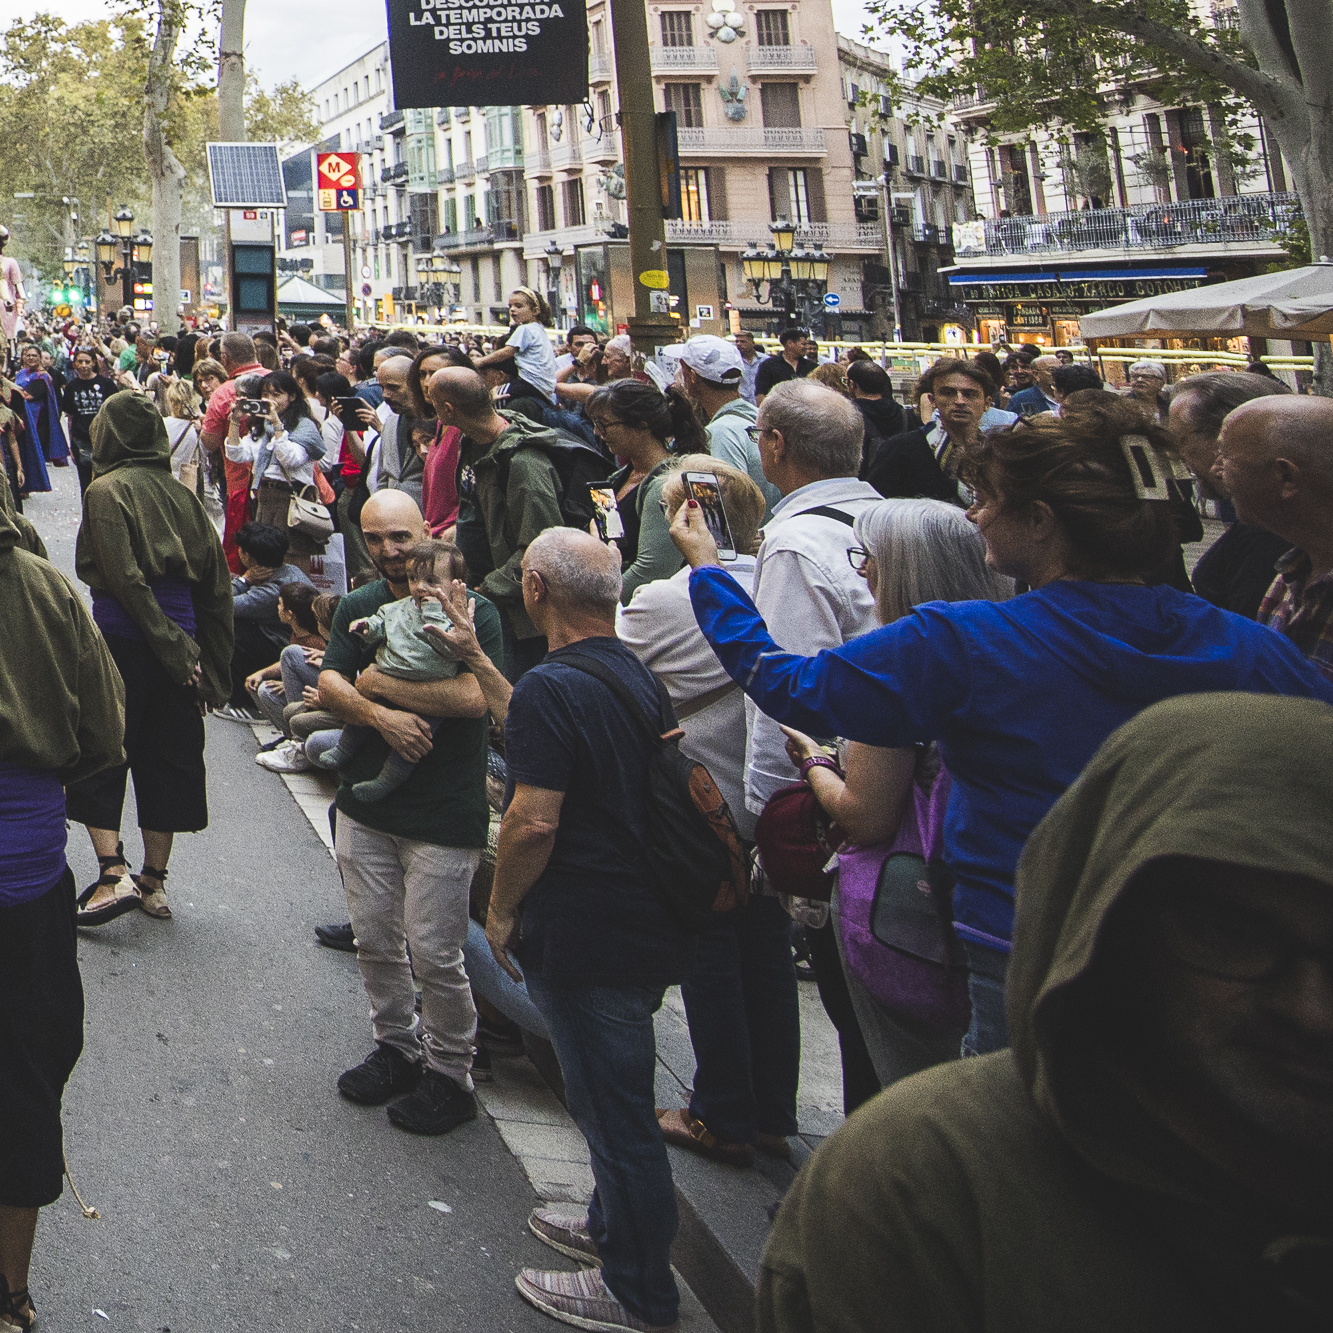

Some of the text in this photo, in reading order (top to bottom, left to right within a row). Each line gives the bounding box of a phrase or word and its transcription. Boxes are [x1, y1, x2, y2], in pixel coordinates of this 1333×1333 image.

[409, 3, 564, 26] LA TEMPORADA
[434, 21, 541, 40] DELS TEUS
[449, 38, 528, 55] SOMNIS
[327, 161, 341, 174] M
[1028, 283, 1060, 298] CASA
